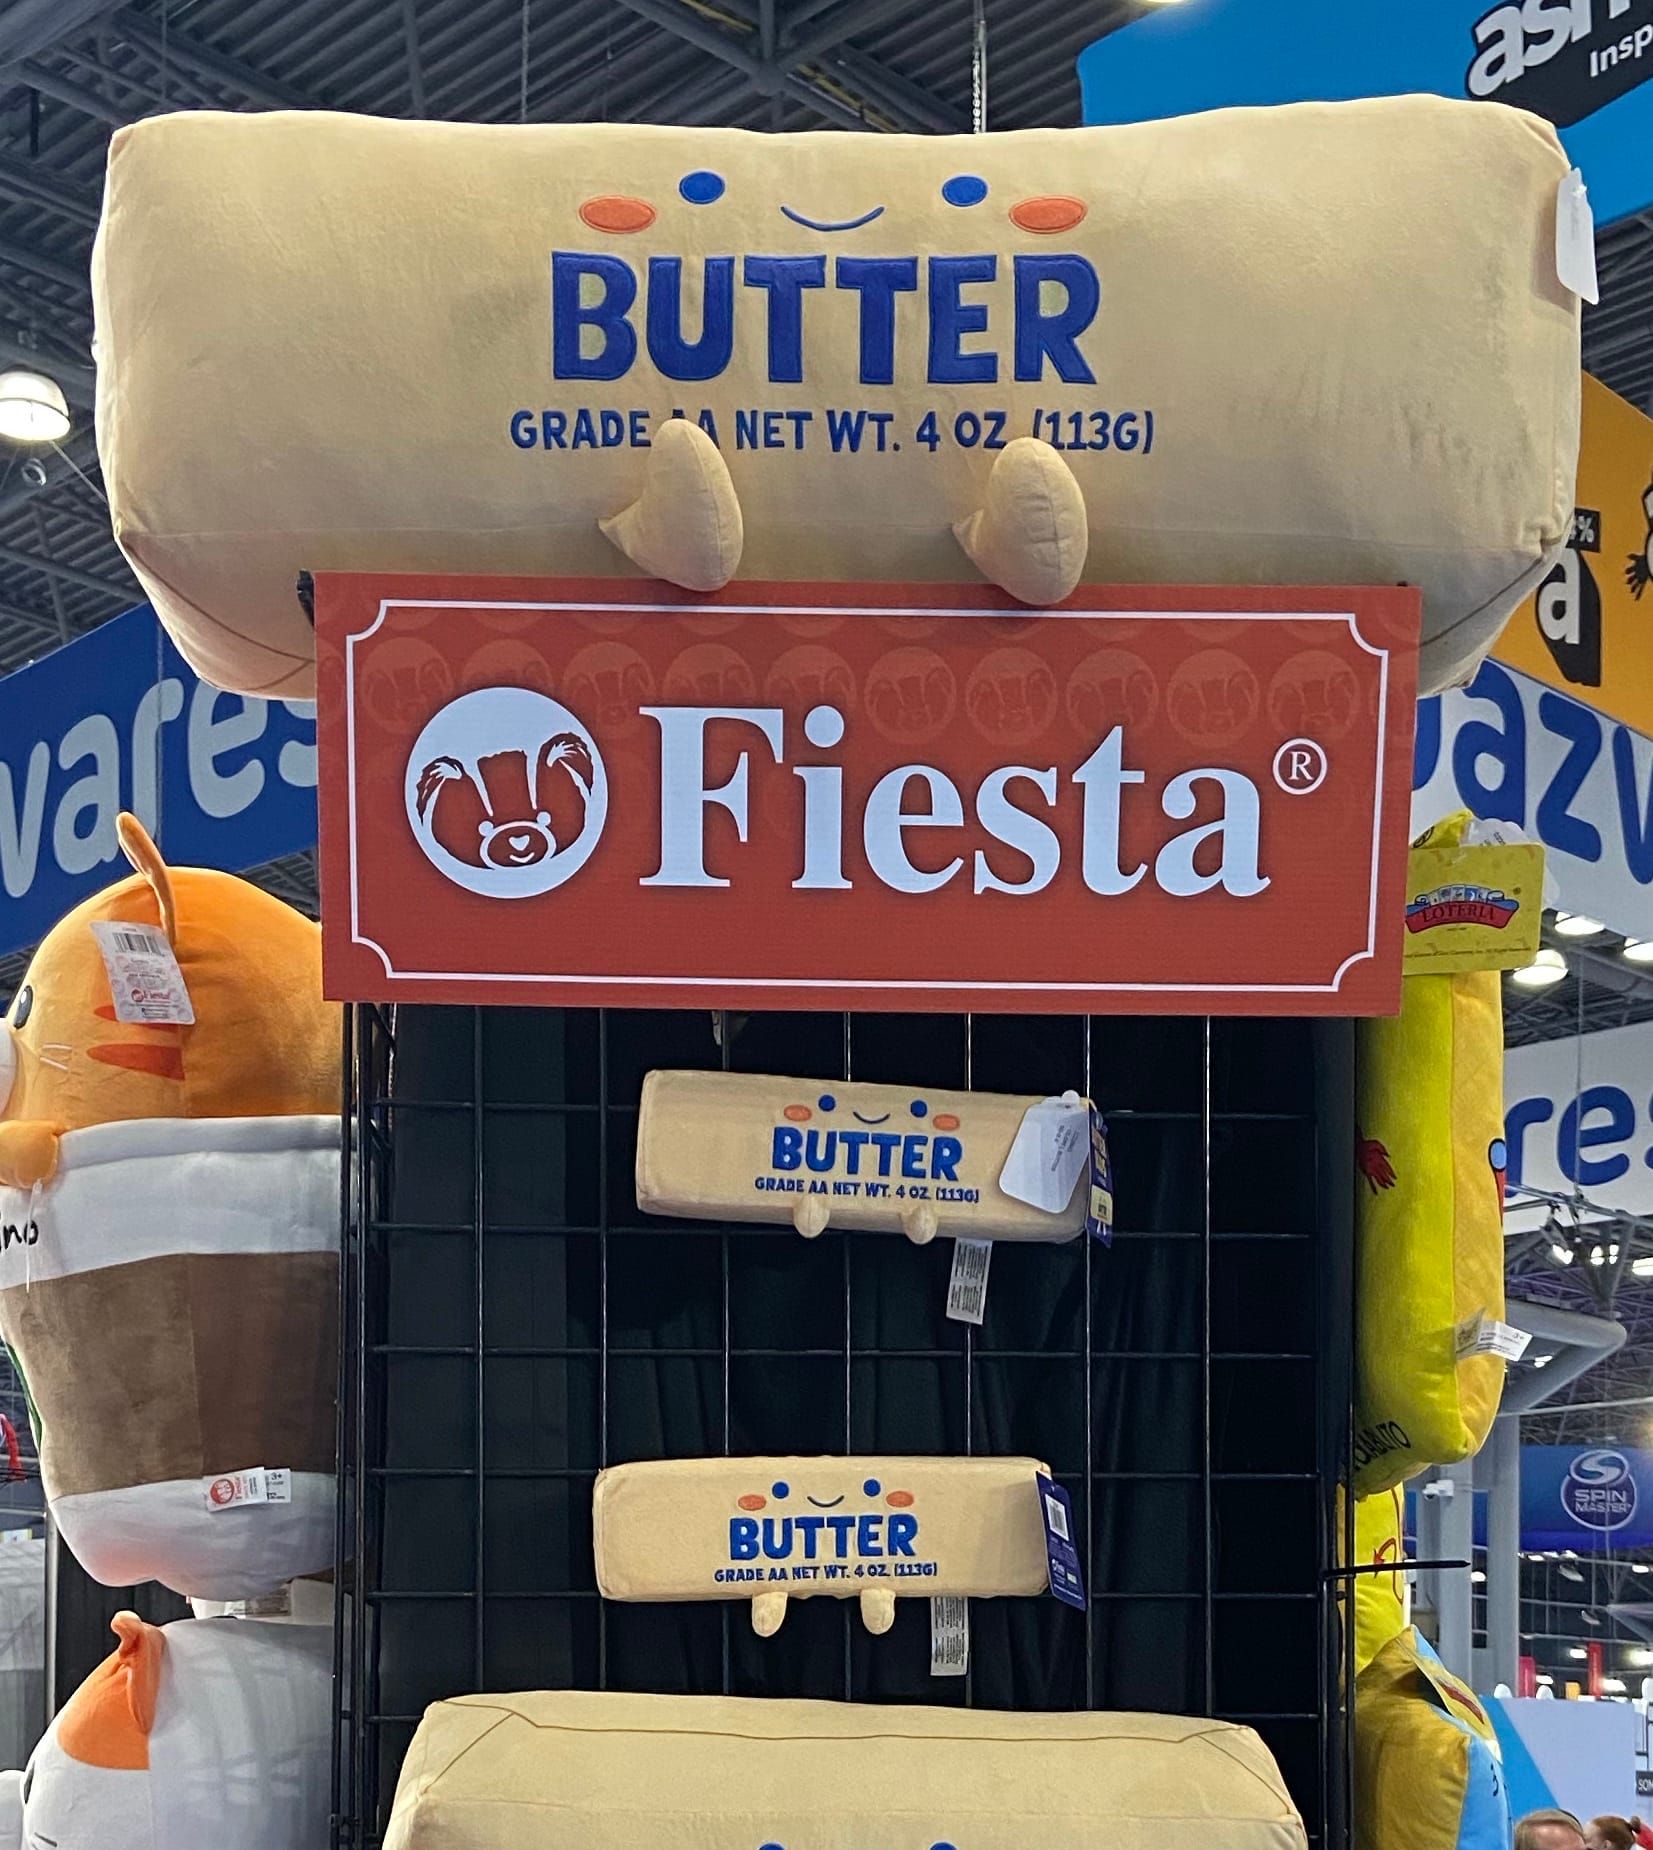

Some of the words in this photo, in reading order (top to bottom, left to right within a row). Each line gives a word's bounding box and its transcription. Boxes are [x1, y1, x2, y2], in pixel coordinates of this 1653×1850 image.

[552, 251, 1101, 385] BUTTER
[510, 408, 651, 450] GRADE
[671, 408, 720, 450] A
[736, 409, 813, 450] NET
[826, 409, 900, 452] WT.
[916, 411, 940, 452] 4
[1032, 408, 1154, 454] (113G)
[638, 703, 1271, 898] Fiesta
[772, 1126, 963, 1181] BUTTER
[1504, 1085, 1653, 1199] re
[755, 1176, 805, 1192] GRADE
[808, 1180, 829, 1195] AA
[833, 1181, 861, 1197] NET
[865, 1182, 891, 1198] WT.
[896, 1185, 905, 1199] 4
[1575, 1489, 1627, 1502] SPIN
[1575, 1502, 1628, 1513] MASTER
[729, 1513, 918, 1560] BUTTER
[714, 1568, 765, 1582] GRADE
[768, 1567, 788, 1581] AA
[792, 1566, 820, 1580] NET
[824, 1564, 850, 1579] WT.
[854, 1564, 864, 1578] 4
